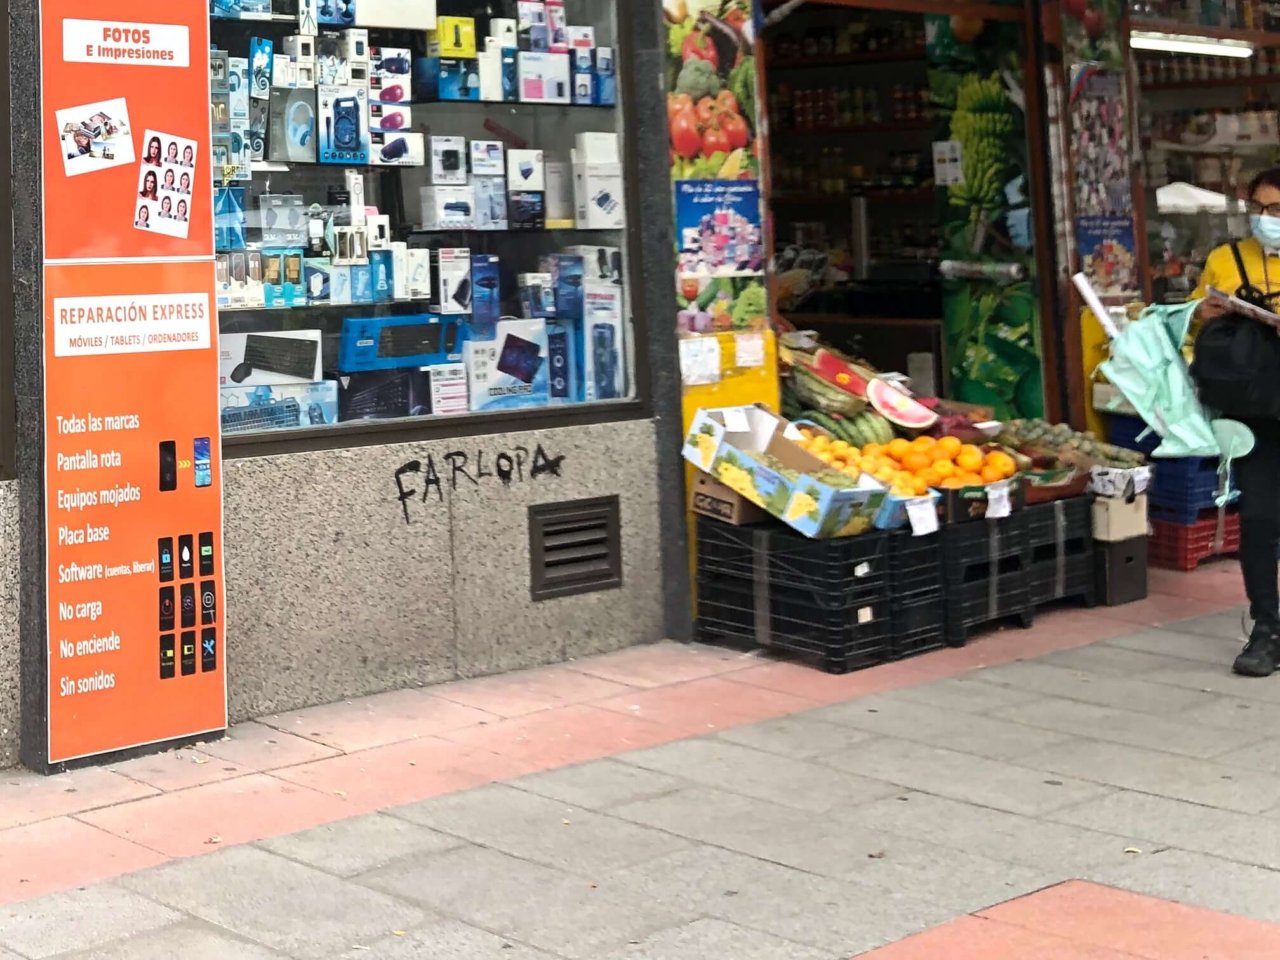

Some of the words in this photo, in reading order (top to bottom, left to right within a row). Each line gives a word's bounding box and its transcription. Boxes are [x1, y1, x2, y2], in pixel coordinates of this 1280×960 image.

[103, 27, 150, 44] FOTOS
[86, 44, 93, 57] E
[97, 45, 174, 61] Impresiones
[60, 301, 147, 325] REPARACIÓN
[153, 302, 205, 321] EXPRESS
[69, 335, 102, 348] MÓVILES
[110, 334, 140, 346] TABLETS
[148, 332, 199, 344] ORDENADORES
[56, 414, 86, 435] Todas
[88, 412, 103, 431] las
[104, 414, 140, 430] marcas
[57, 450, 98, 471] Pantalla
[100, 450, 122, 468] rota
[395, 443, 565, 525] FARLOPA
[57, 489, 97, 512] Equipos
[99, 484, 141, 506] mojados
[58, 524, 85, 546] Placa
[87, 523, 109, 542] base
[58, 561, 102, 584] Software
[59, 603, 74, 621] No
[76, 601, 102, 622] carga
[60, 640, 74, 658] No
[76, 631, 121, 655] enciende
[60, 677, 76, 697] Sin
[78, 671, 116, 693] sonidos
